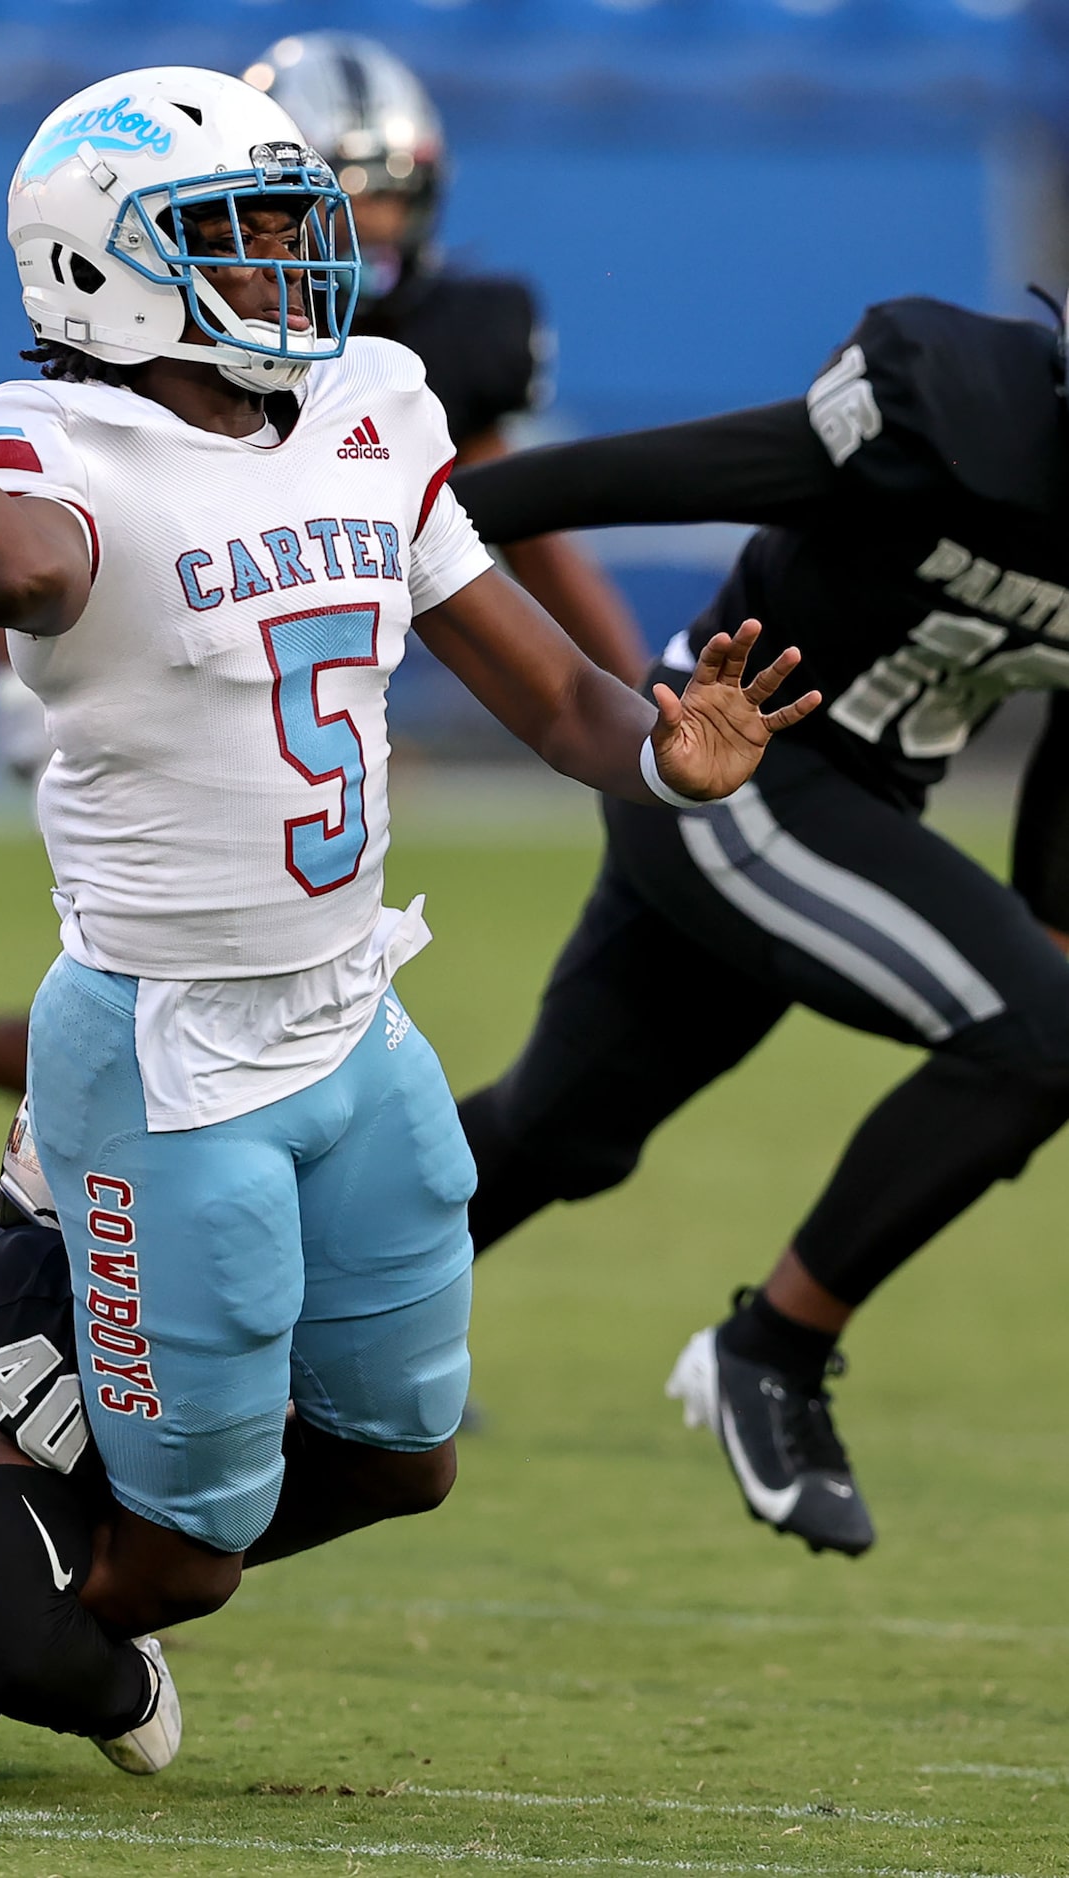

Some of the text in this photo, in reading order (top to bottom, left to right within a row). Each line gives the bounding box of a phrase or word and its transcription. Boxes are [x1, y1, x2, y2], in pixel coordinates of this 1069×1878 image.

[36, 97, 171, 155] wboys
[337, 443, 390, 460] adidas
[175, 518, 403, 612] CARTER
[258, 602, 380, 898] 5
[83, 1171, 162, 1421] COWBOYS
